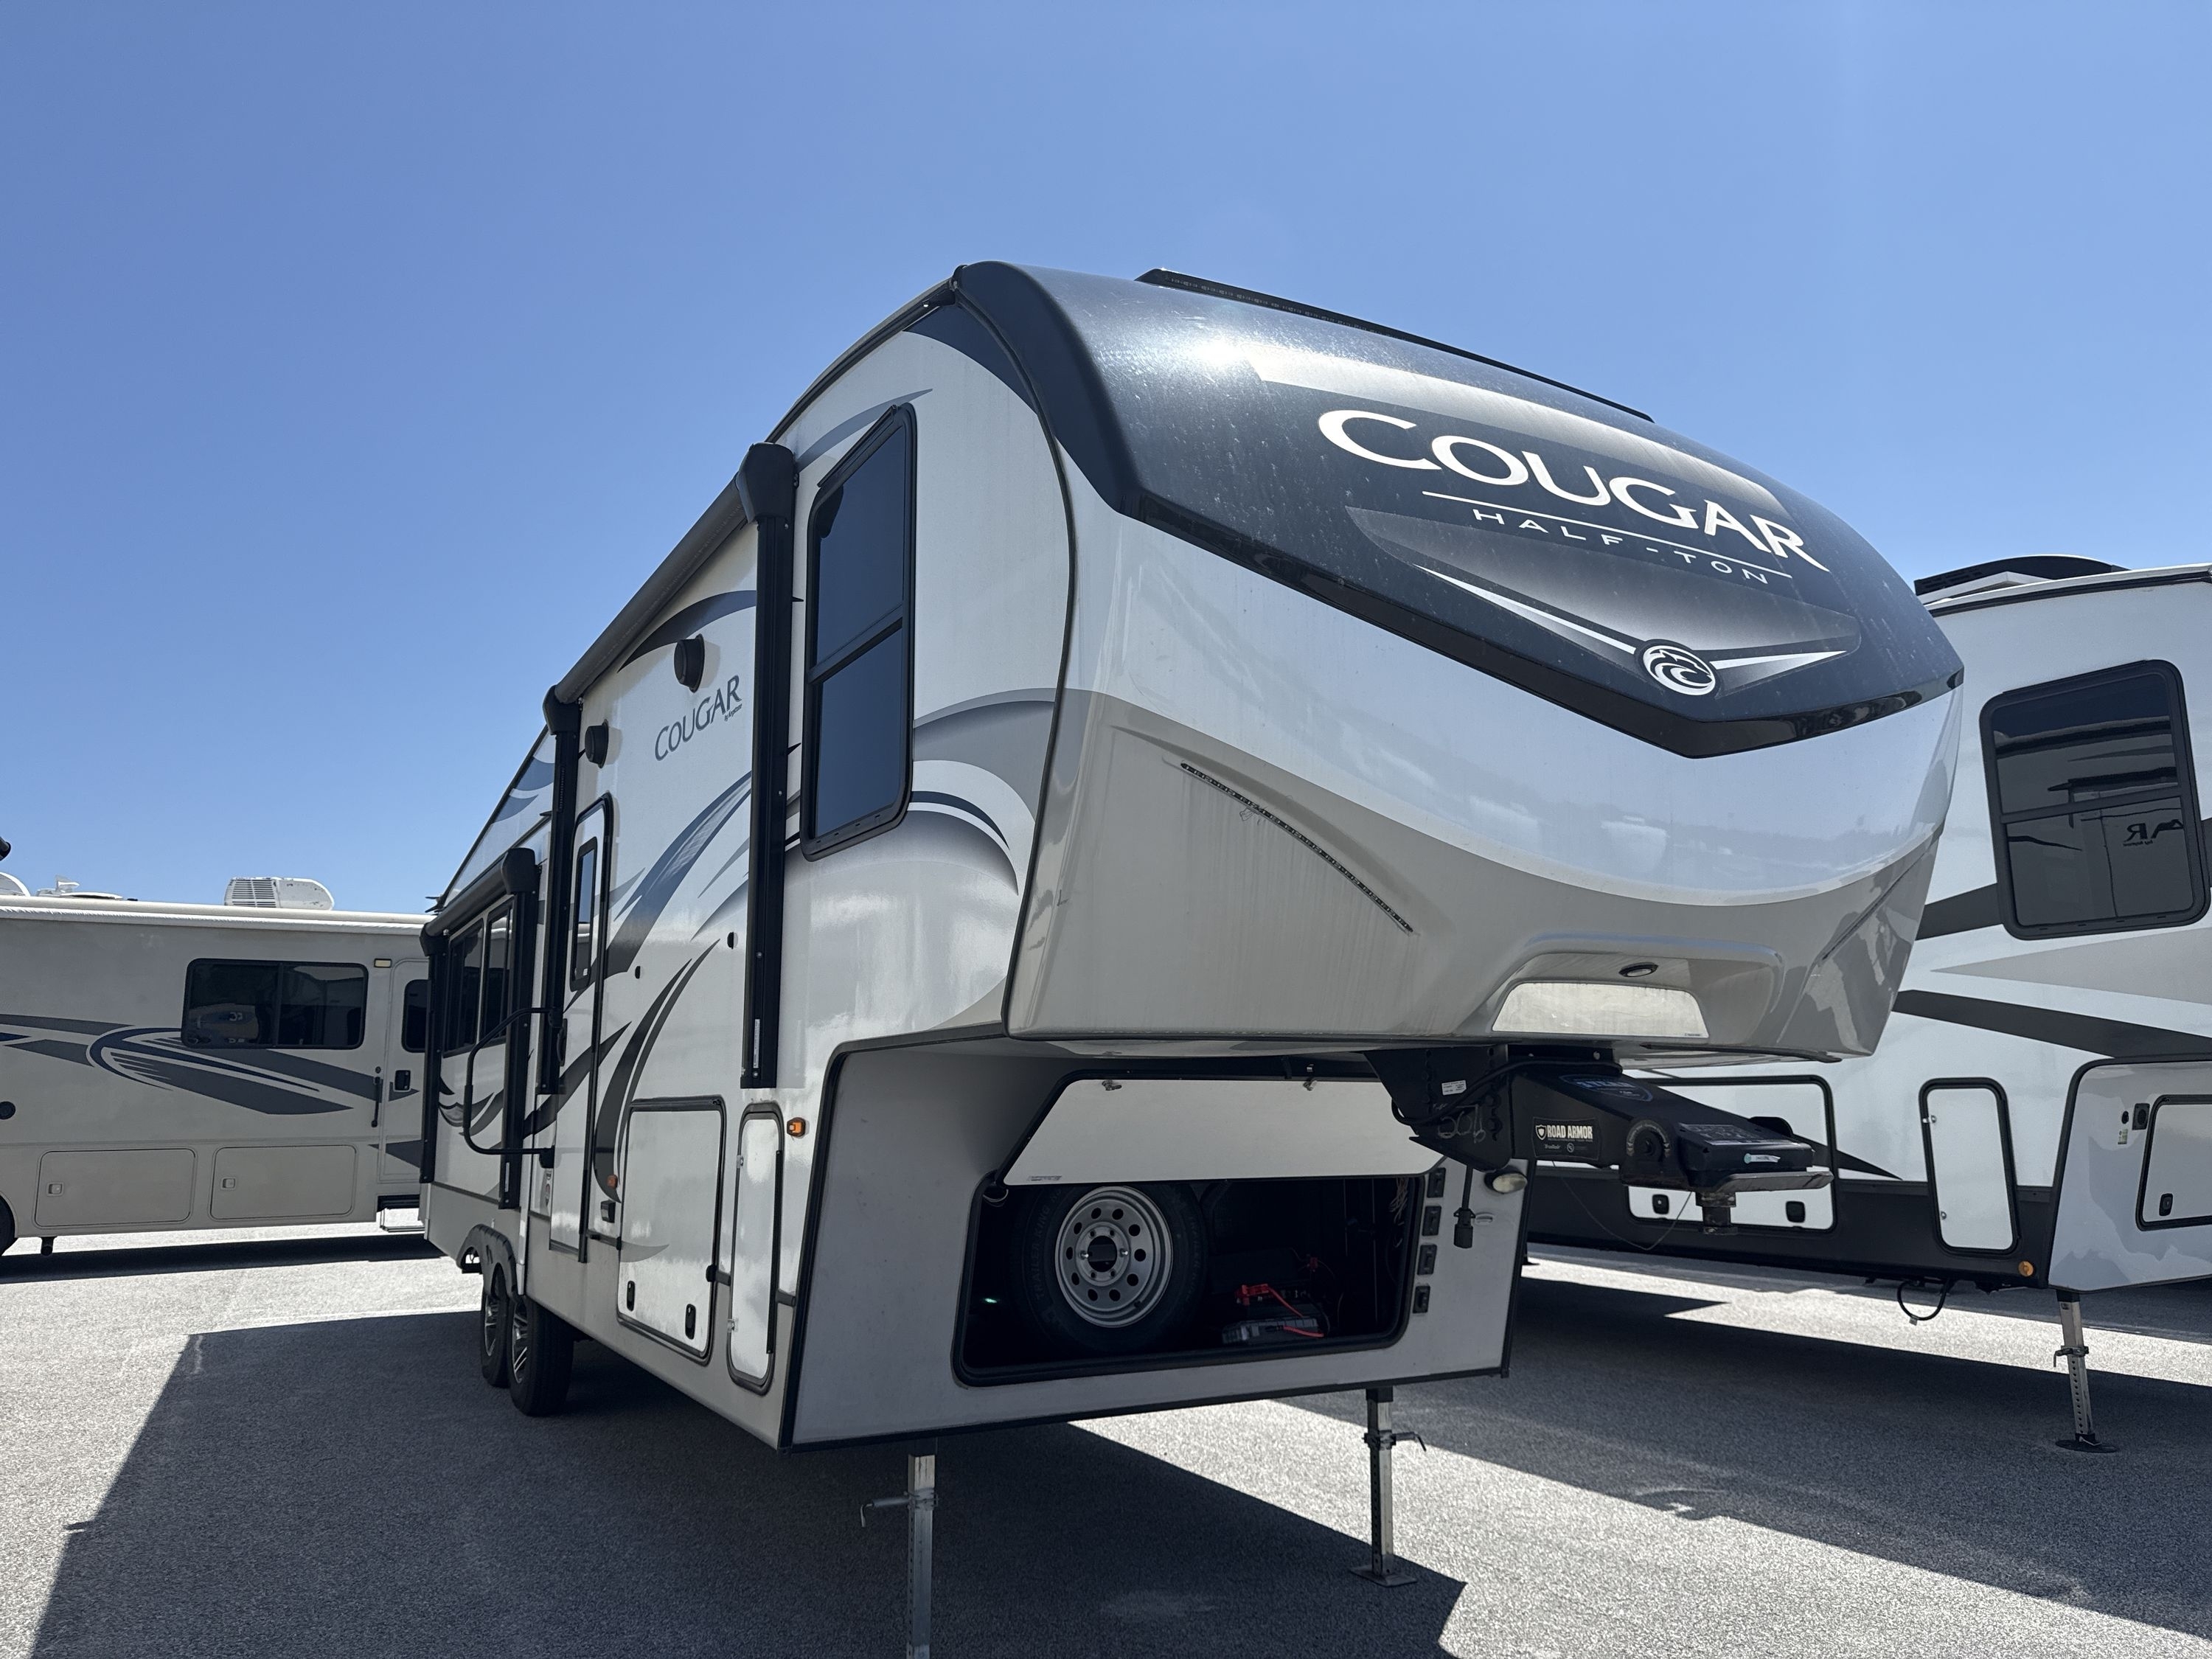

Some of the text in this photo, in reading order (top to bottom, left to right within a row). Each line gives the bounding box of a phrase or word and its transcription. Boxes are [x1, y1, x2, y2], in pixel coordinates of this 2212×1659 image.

[1317, 409, 1830, 572] COUGAR
[655, 674, 742, 761] COUGAR
[1547, 1124, 1593, 1140] ROAD ARMOR
